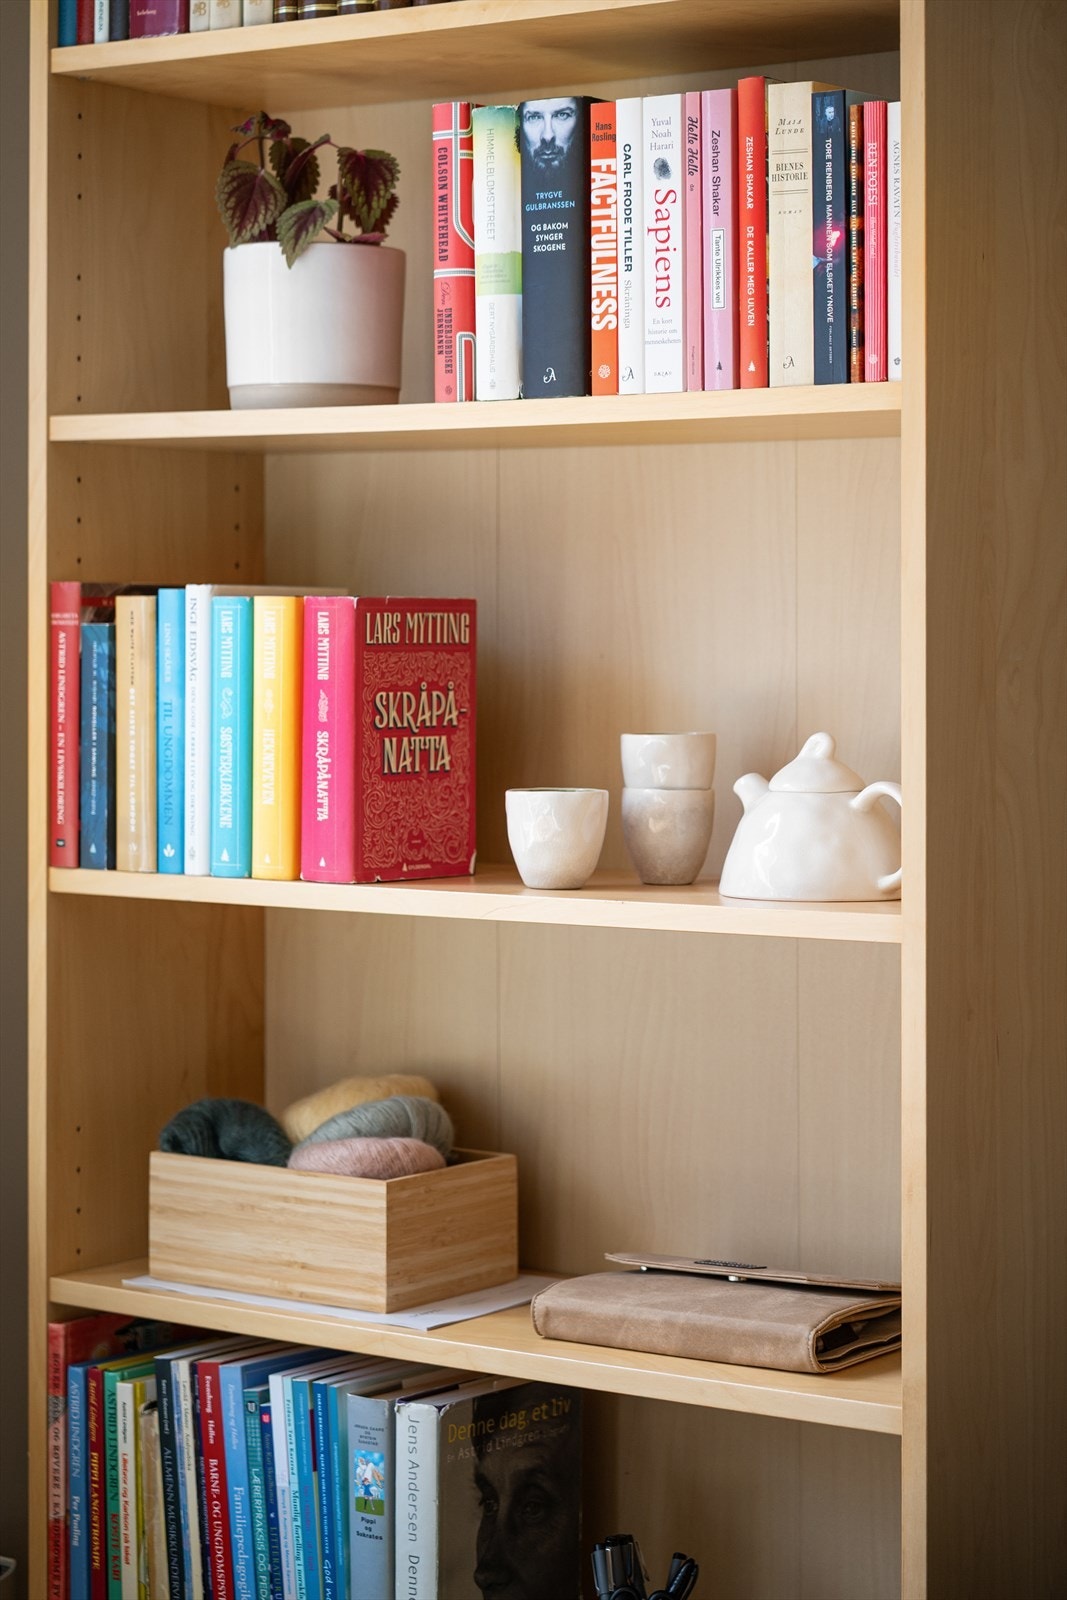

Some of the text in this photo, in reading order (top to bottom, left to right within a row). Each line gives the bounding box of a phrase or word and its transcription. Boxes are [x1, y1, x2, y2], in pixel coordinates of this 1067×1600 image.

[591, 132, 617, 143] Rosling
[595, 122, 612, 131] Hans
[651, 116, 672, 126] Yuval
[651, 129, 672, 138] Noah
[650, 141, 674, 151] Harari
[687, 116, 698, 177] Helle Helle
[867, 142, 877, 169] REN
[486, 128, 496, 241] HIMMELBLOMSTTREET
[711, 130, 721, 217] Zeshan Shakar
[771, 172, 808, 182] HISTORIE
[776, 162, 804, 172] BIENES
[437, 147, 449, 262] COLSON WHITEHEAD
[525, 201, 575, 212] GULBRANSSEN
[535, 191, 563, 200] TRYGVE
[867, 171, 878, 206] POESI
[893, 177, 901, 218] RAVATN
[531, 222, 569, 232] OG BAKOM
[535, 233, 563, 242] SYNGER
[591, 158, 618, 331] FACTFULNESS
[622, 144, 633, 329] CARL FRODE TILLER Skråninga
[745, 137, 755, 327] ZESHAN SHAKAR DE KALLER MEG ULVEN
[824, 138, 834, 323] TORE RENBERG MANNEN SOM ELSKET YNGVE
[533, 243, 566, 253] SKOGENE
[647, 189, 677, 309] Sapiens
[713, 234, 723, 304] Tante Ulrikkes vei
[436, 308, 444, 355] JERNBANEN
[444, 308, 453, 374] UNDERJORDISKE
[189, 597, 198, 628] INGE
[262, 610, 276, 635] LARS
[365, 611, 471, 646] LARS MYTTING
[57, 631, 67, 669] ASTRID
[189, 630, 199, 682] EIDSVÅG
[262, 636, 276, 680] MYTTING
[57, 670, 66, 724] LINDGREN
[163, 699, 174, 721] TIL
[315, 611, 332, 822] LARS MYTTING SKRÅPÅNATTA
[373, 681, 468, 735] SKRÅPÅ-
[218, 610, 233, 829] LARS MYTTING SØSTERKLOKKENE
[382, 736, 452, 775] NATTA
[162, 725, 174, 826] UNGDOMMEN
[204, 1375, 214, 1413] Evenshaug
[52, 1426, 61, 1442] OG
[207, 1420, 215, 1445] Hallen
[407, 1414, 420, 1455] Jens
[447, 1418, 496, 1444] Denne
[531, 1403, 549, 1421] et
[551, 1396, 572, 1417] liv
[70, 1380, 81, 1547] ASTRID LINDGREN Per Pusling
[107, 1388, 119, 1502] ASTRID LINDGREN
[90, 1451, 99, 1481] PIPPI
[163, 1447, 175, 1501] ALLMENN
[208, 1458, 220, 1498] BARNE-
[212, 1500, 222, 1518] OG
[252, 1468, 266, 1551] LÆRERPRAKSIS
[291, 1489, 301, 1523] Muntlig
[408, 1459, 421, 1542] Andersen
[91, 1483, 101, 1570] LANGSTRØMPE
[356, 1530, 383, 1541] Sokrates
[360, 1516, 377, 1525] Pippi
[258, 1553, 267, 1572] OG
[323, 1559, 333, 1584] God
